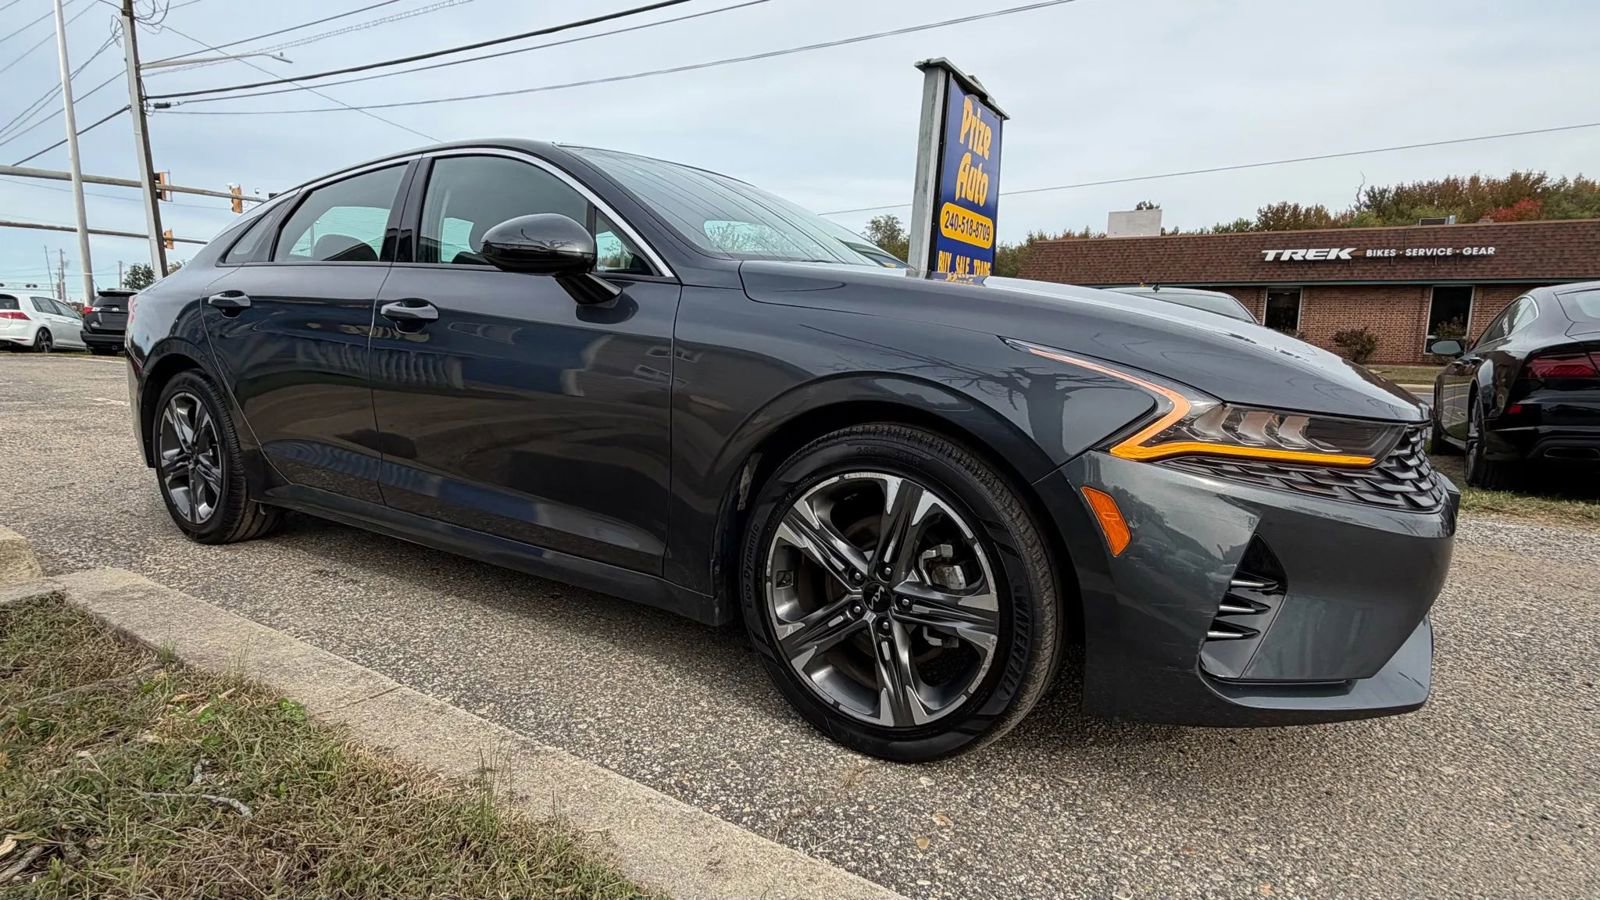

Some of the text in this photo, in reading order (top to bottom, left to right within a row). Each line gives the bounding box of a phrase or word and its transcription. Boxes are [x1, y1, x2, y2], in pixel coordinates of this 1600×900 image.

[960, 95, 992, 160] Prize
[955, 152, 989, 207] Auto
[944, 210, 991, 242] 240-518-8709
[1261, 246, 1496, 261] TREK BIKES SERVICE GEAR
